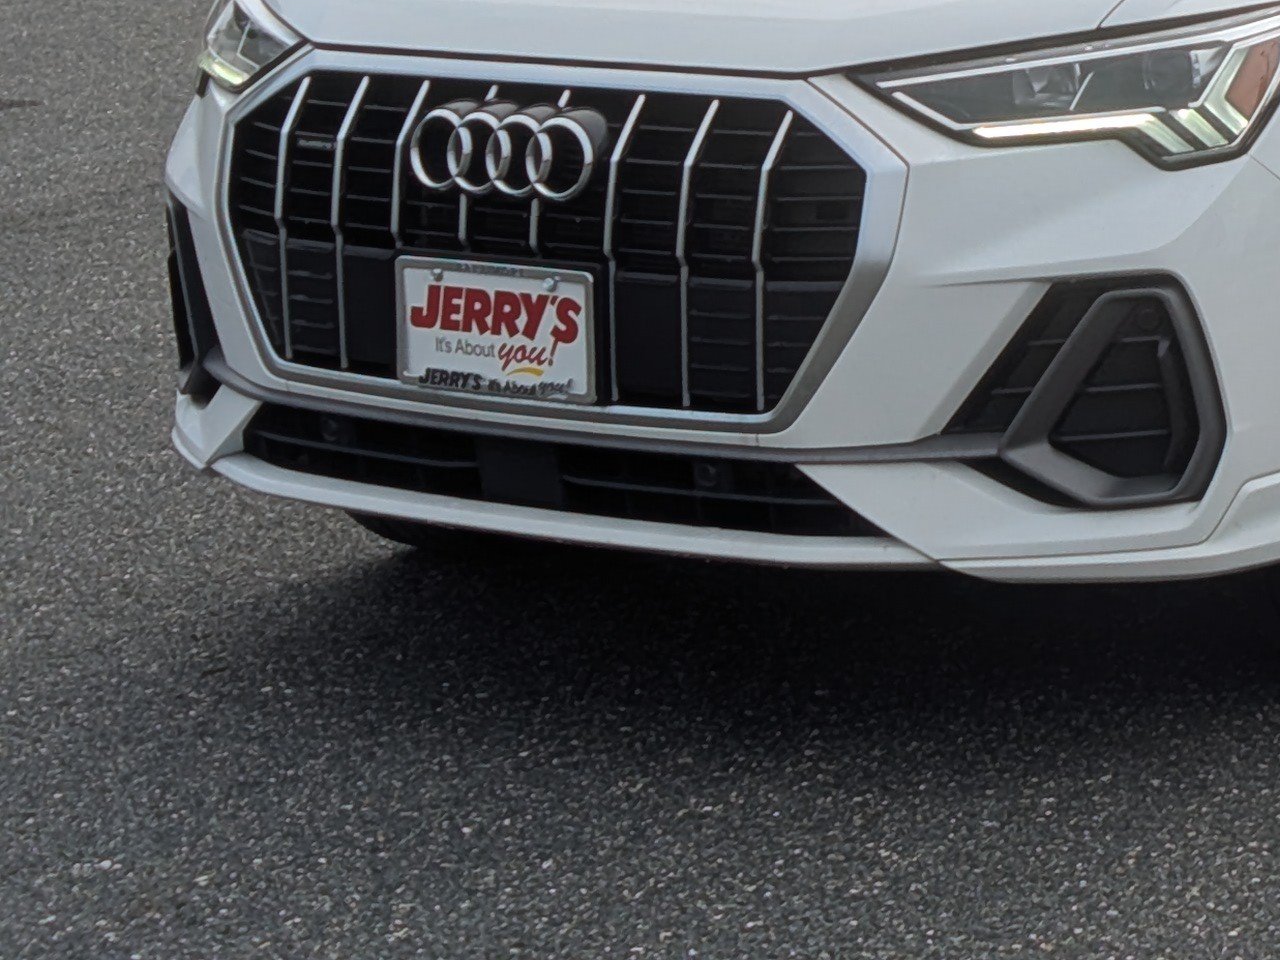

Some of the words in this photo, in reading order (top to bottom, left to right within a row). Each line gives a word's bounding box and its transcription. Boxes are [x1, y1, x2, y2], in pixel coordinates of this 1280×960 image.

[410, 284, 582, 344] JERRY'S
[435, 336, 453, 354] It's
[454, 338, 495, 359] About
[497, 338, 559, 372] you!
[418, 367, 484, 390] JERRY'S
